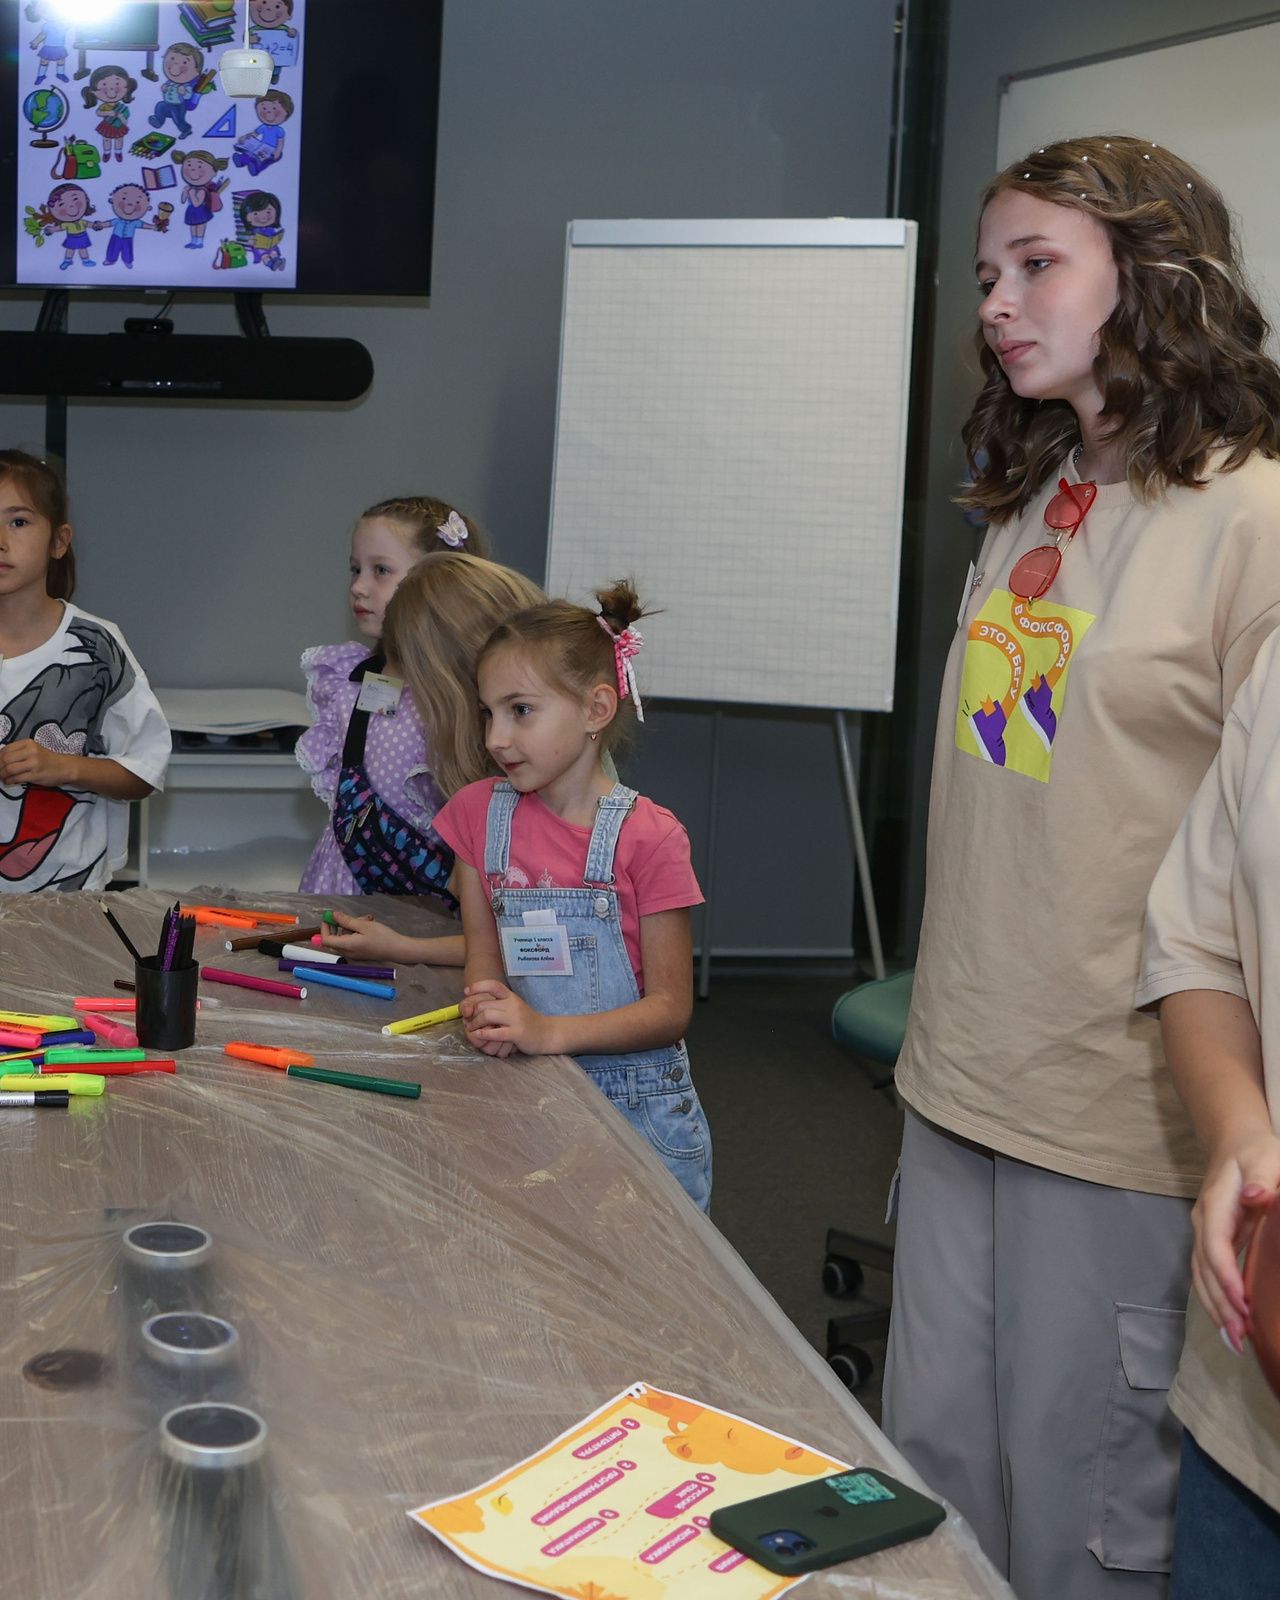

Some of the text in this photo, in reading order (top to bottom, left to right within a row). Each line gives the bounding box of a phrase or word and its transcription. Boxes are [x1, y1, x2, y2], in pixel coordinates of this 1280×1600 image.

[1014, 604, 1070, 668] В ФОКСФОРД
[979, 625, 1022, 699] ЭТО Я БЕГУ
[577, 1429, 623, 1458] ЛИТЕРАТУРА
[536, 1469, 619, 1525] ПРОГРАММИРОВАНИЕ
[546, 1519, 601, 1554] МАТЕМАТИКА
[645, 1527, 695, 1562] ЭКОНОМИКА
